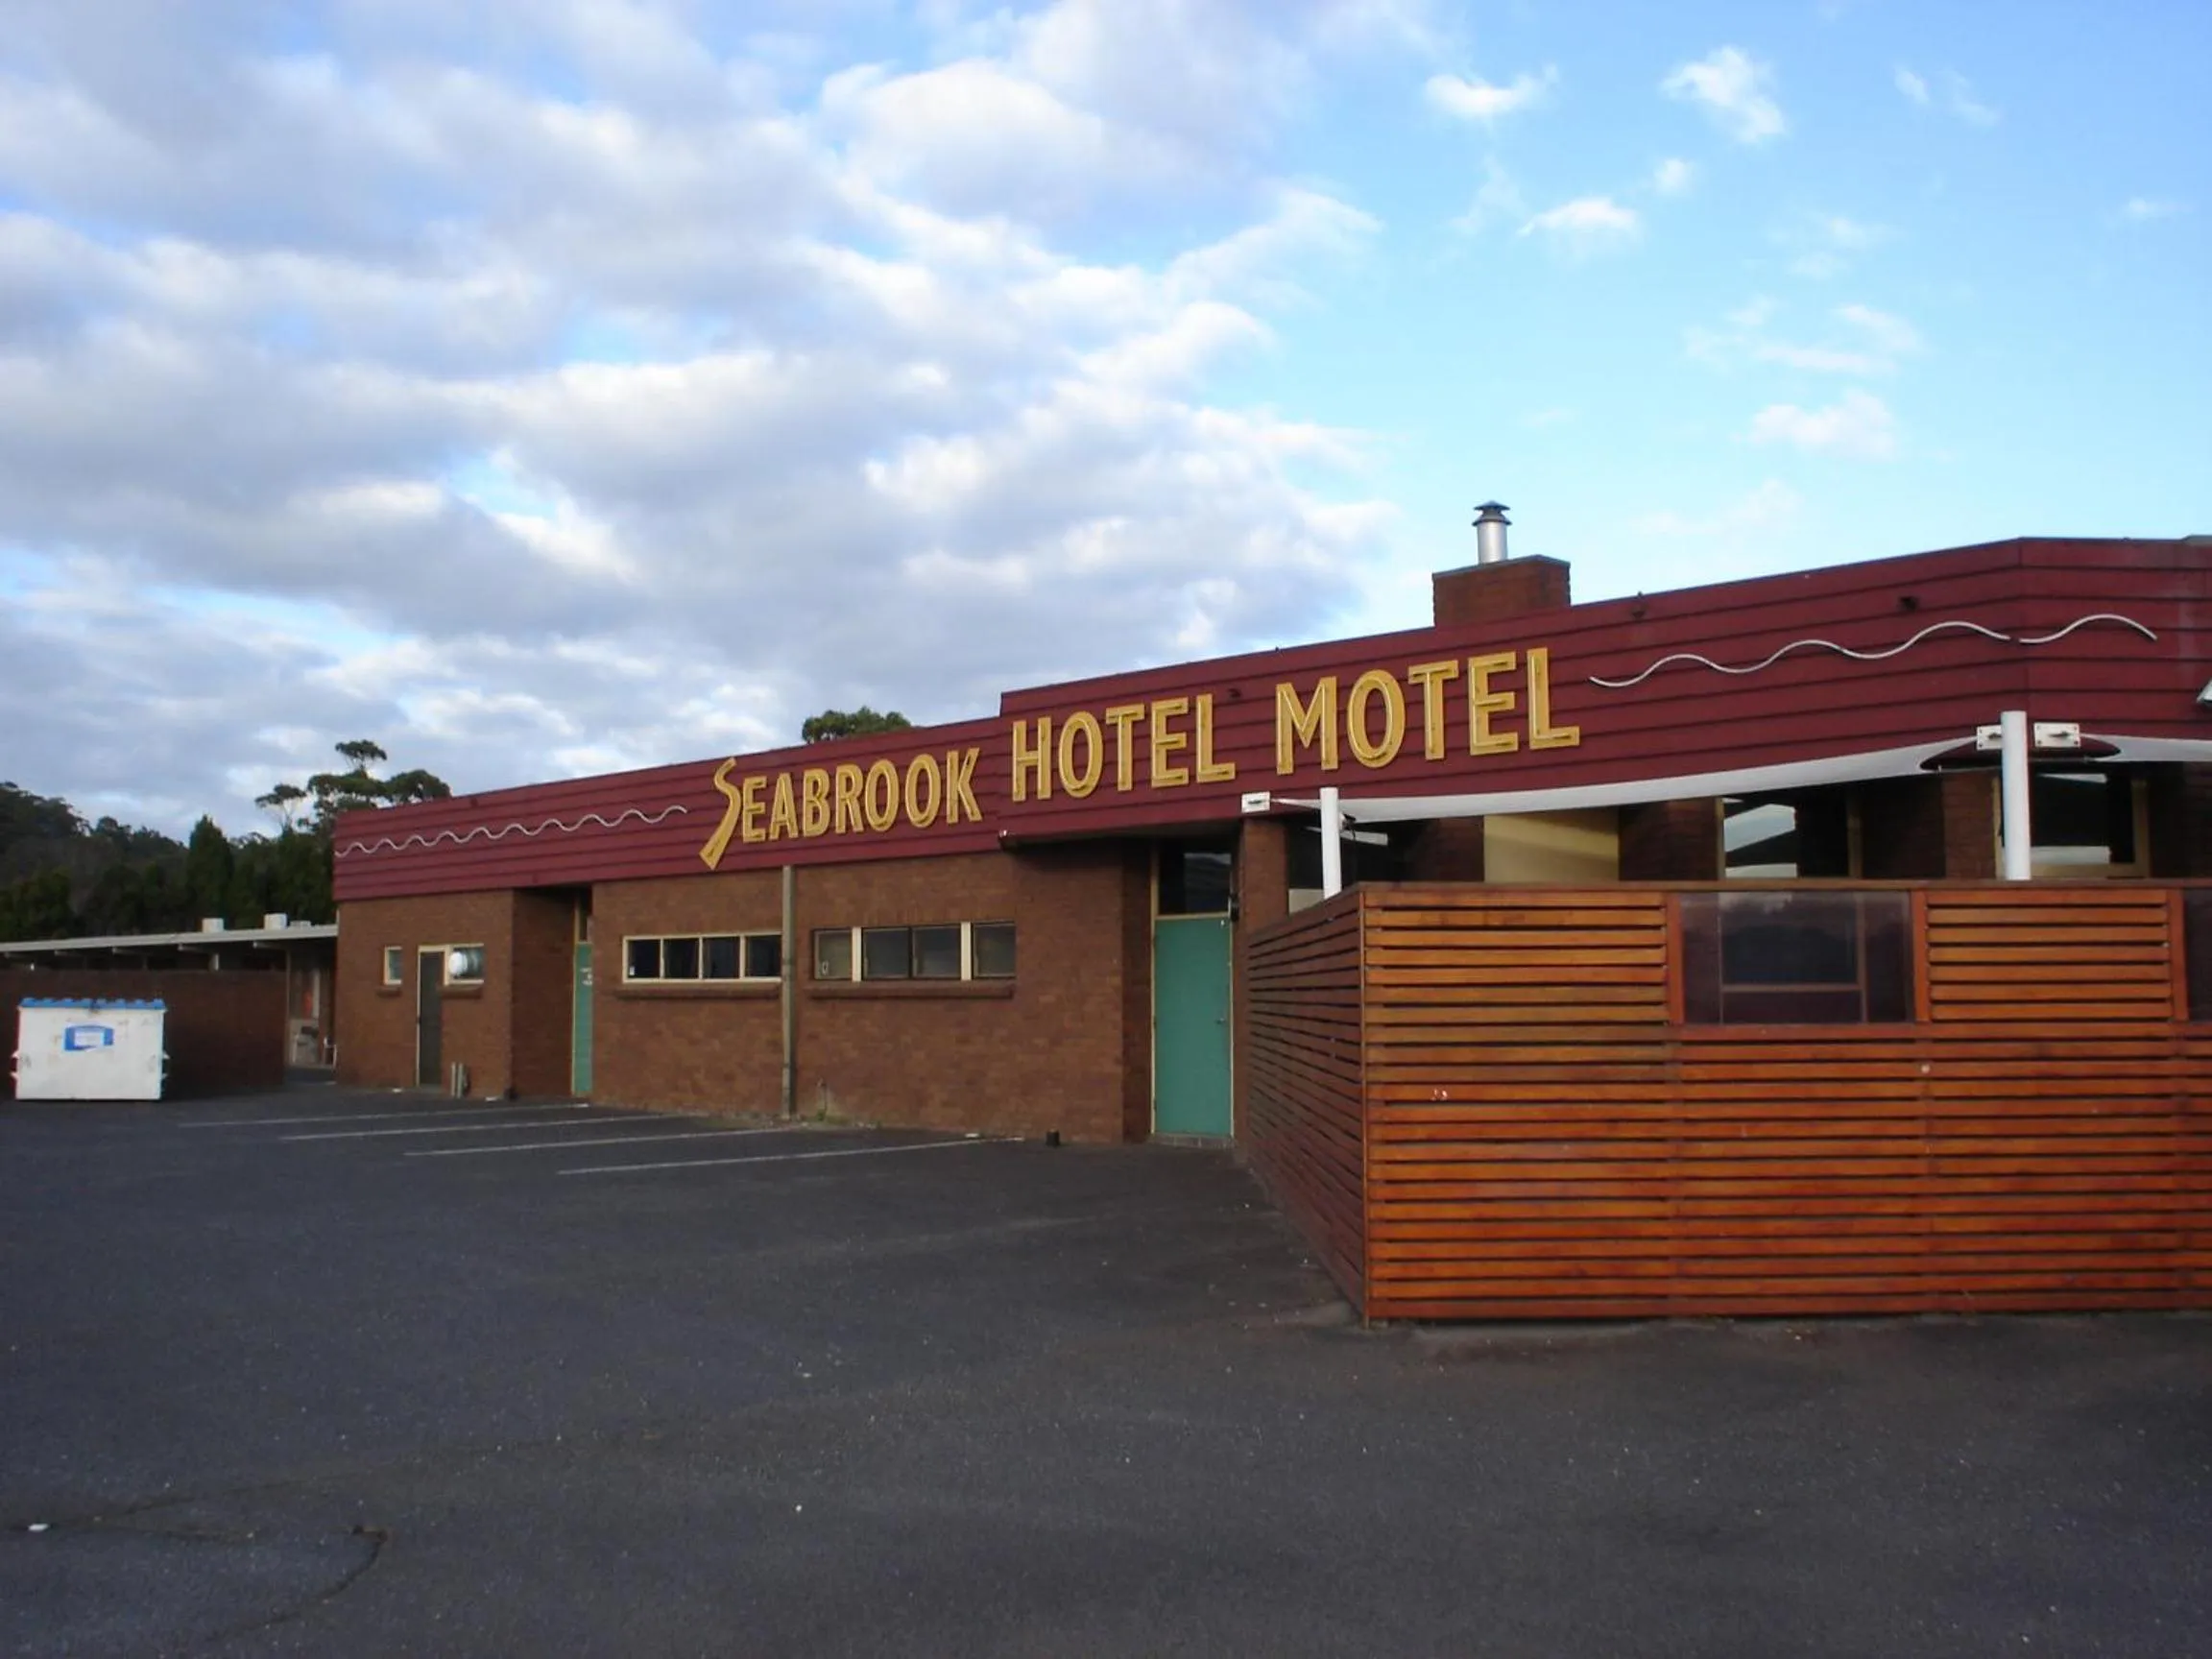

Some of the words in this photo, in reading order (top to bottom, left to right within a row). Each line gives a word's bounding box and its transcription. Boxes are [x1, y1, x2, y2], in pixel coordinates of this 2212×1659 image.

[699, 747, 982, 870] SEABROOK
[1012, 693, 1236, 802] HOTEL
[1275, 647, 1581, 775] MOTEL
